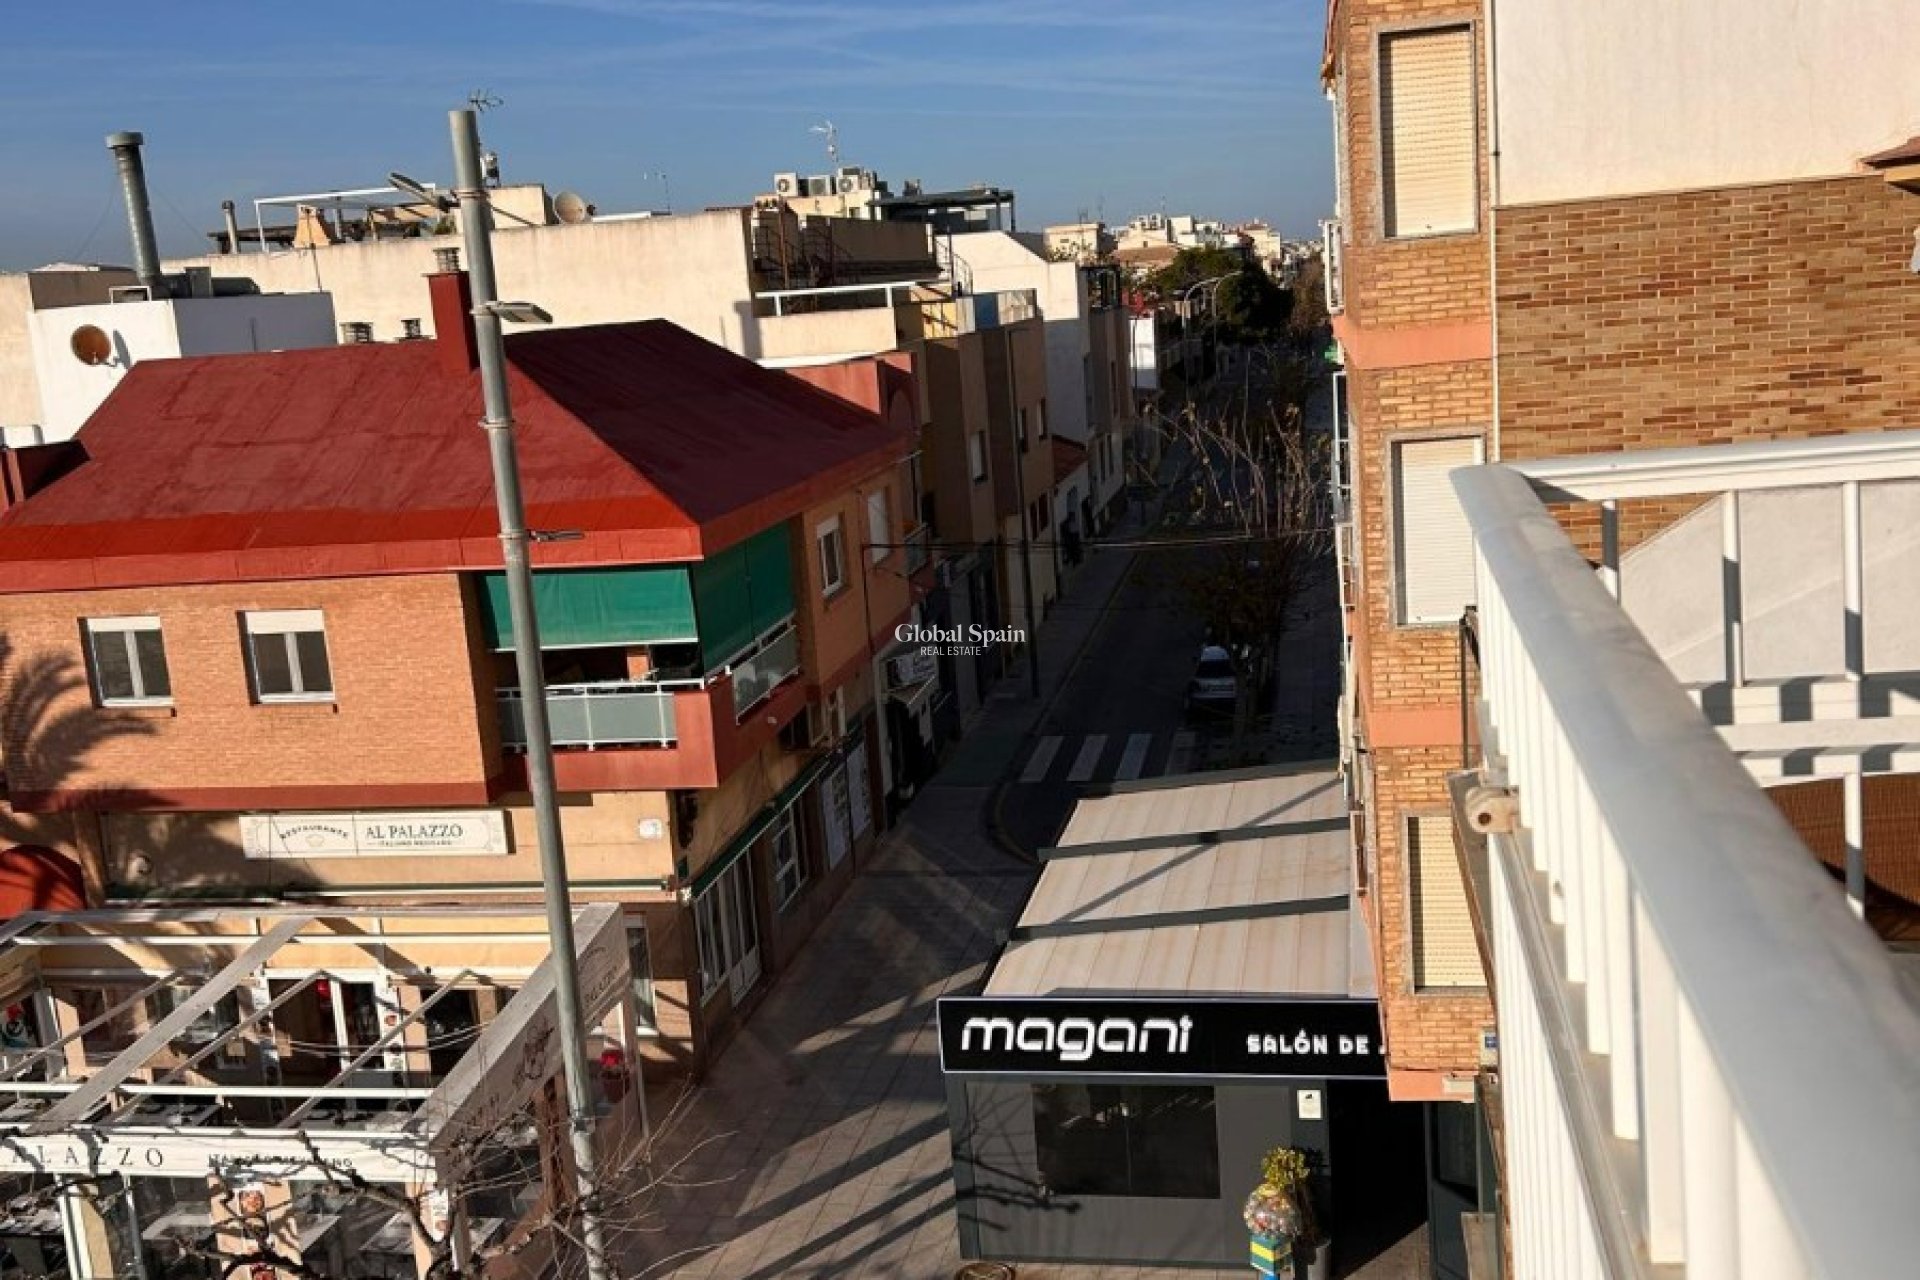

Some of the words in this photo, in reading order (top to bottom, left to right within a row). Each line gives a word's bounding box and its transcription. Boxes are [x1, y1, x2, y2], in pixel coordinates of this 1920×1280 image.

[366, 825, 385, 839] AL
[388, 823, 463, 839] PALAZZO
[961, 1014, 1193, 1061] magani
[1247, 1028, 1328, 1055] SALÓN
[1339, 1034, 1369, 1055] DE
